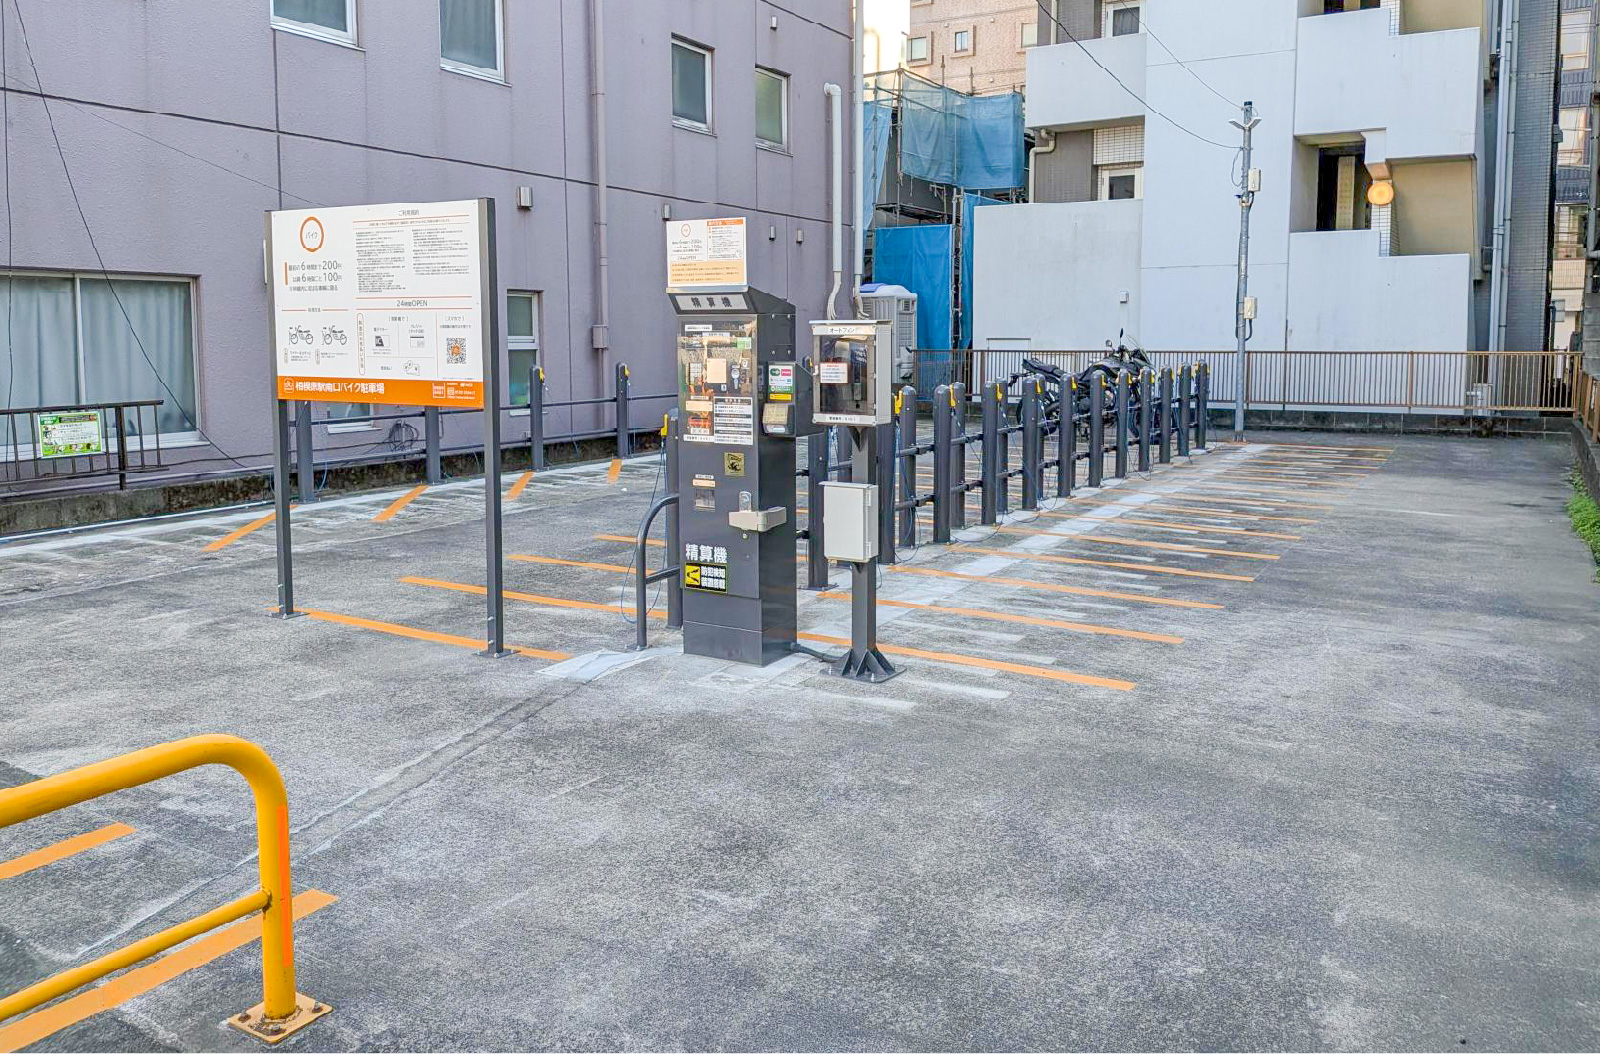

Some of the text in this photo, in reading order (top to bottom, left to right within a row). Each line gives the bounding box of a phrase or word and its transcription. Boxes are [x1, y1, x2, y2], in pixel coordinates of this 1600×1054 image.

[295, 381, 385, 394] 相模原駅南口バイク駐車場
[685, 543, 727, 563] 精算機
